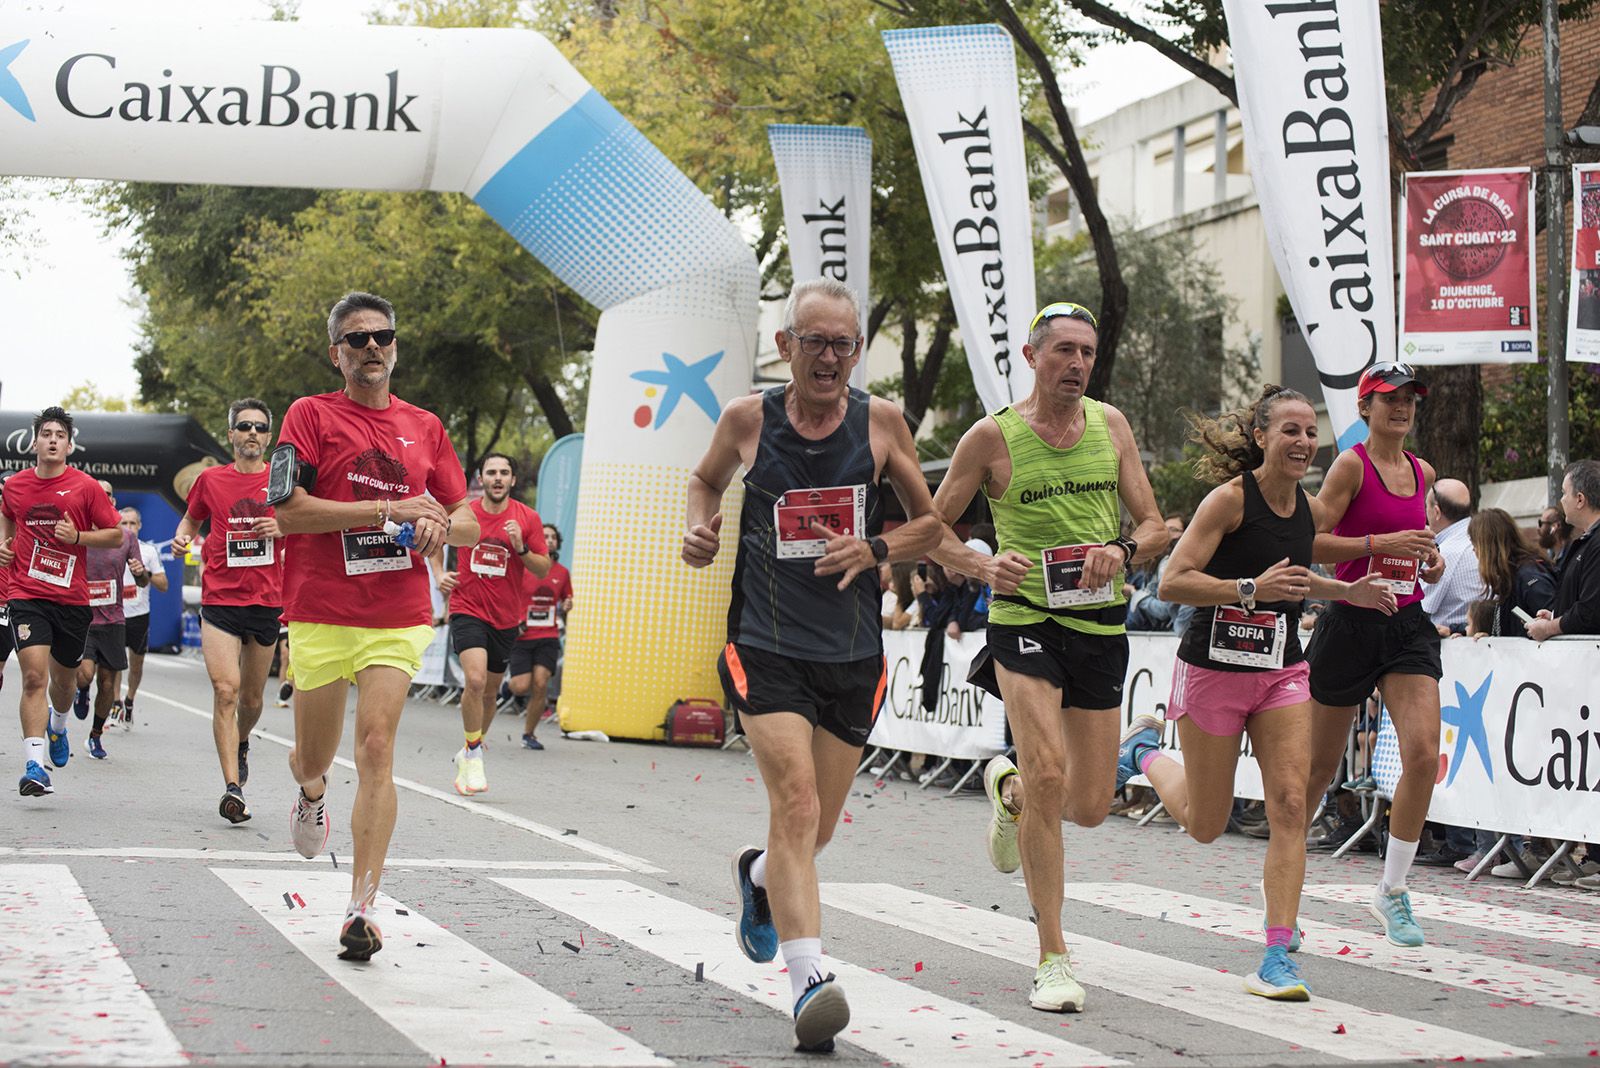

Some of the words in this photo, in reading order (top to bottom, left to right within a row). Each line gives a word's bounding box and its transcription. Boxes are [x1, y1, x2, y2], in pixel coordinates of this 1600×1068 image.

[55, 53, 421, 132] CaixaBank
[1422, 207, 1438, 225] LA
[1433, 186, 1471, 210] CURSA
[1473, 186, 1490, 200] DE
[938, 105, 1013, 380] aixaBank
[1419, 233, 1453, 246] SANT
[1455, 232, 1496, 246] CUGAT
[1439, 285, 1496, 297] DIUMENGE,
[1431, 299, 1445, 310] 16
[1446, 297, 1504, 309] D'OCTUBRE
[346, 472, 370, 485] SANT
[369, 477, 395, 492] CUGAT
[1020, 480, 1117, 504] QuiroRunners
[797, 513, 840, 530] 1075
[237, 541, 258, 550] LLUIS
[357, 534, 395, 546] VICENTE
[40, 557, 62, 570] MIKEL
[482, 552, 499, 561] ABEL
[1382, 557, 1413, 567] ESTEFANIA
[1228, 625, 1265, 641] SOFIA
